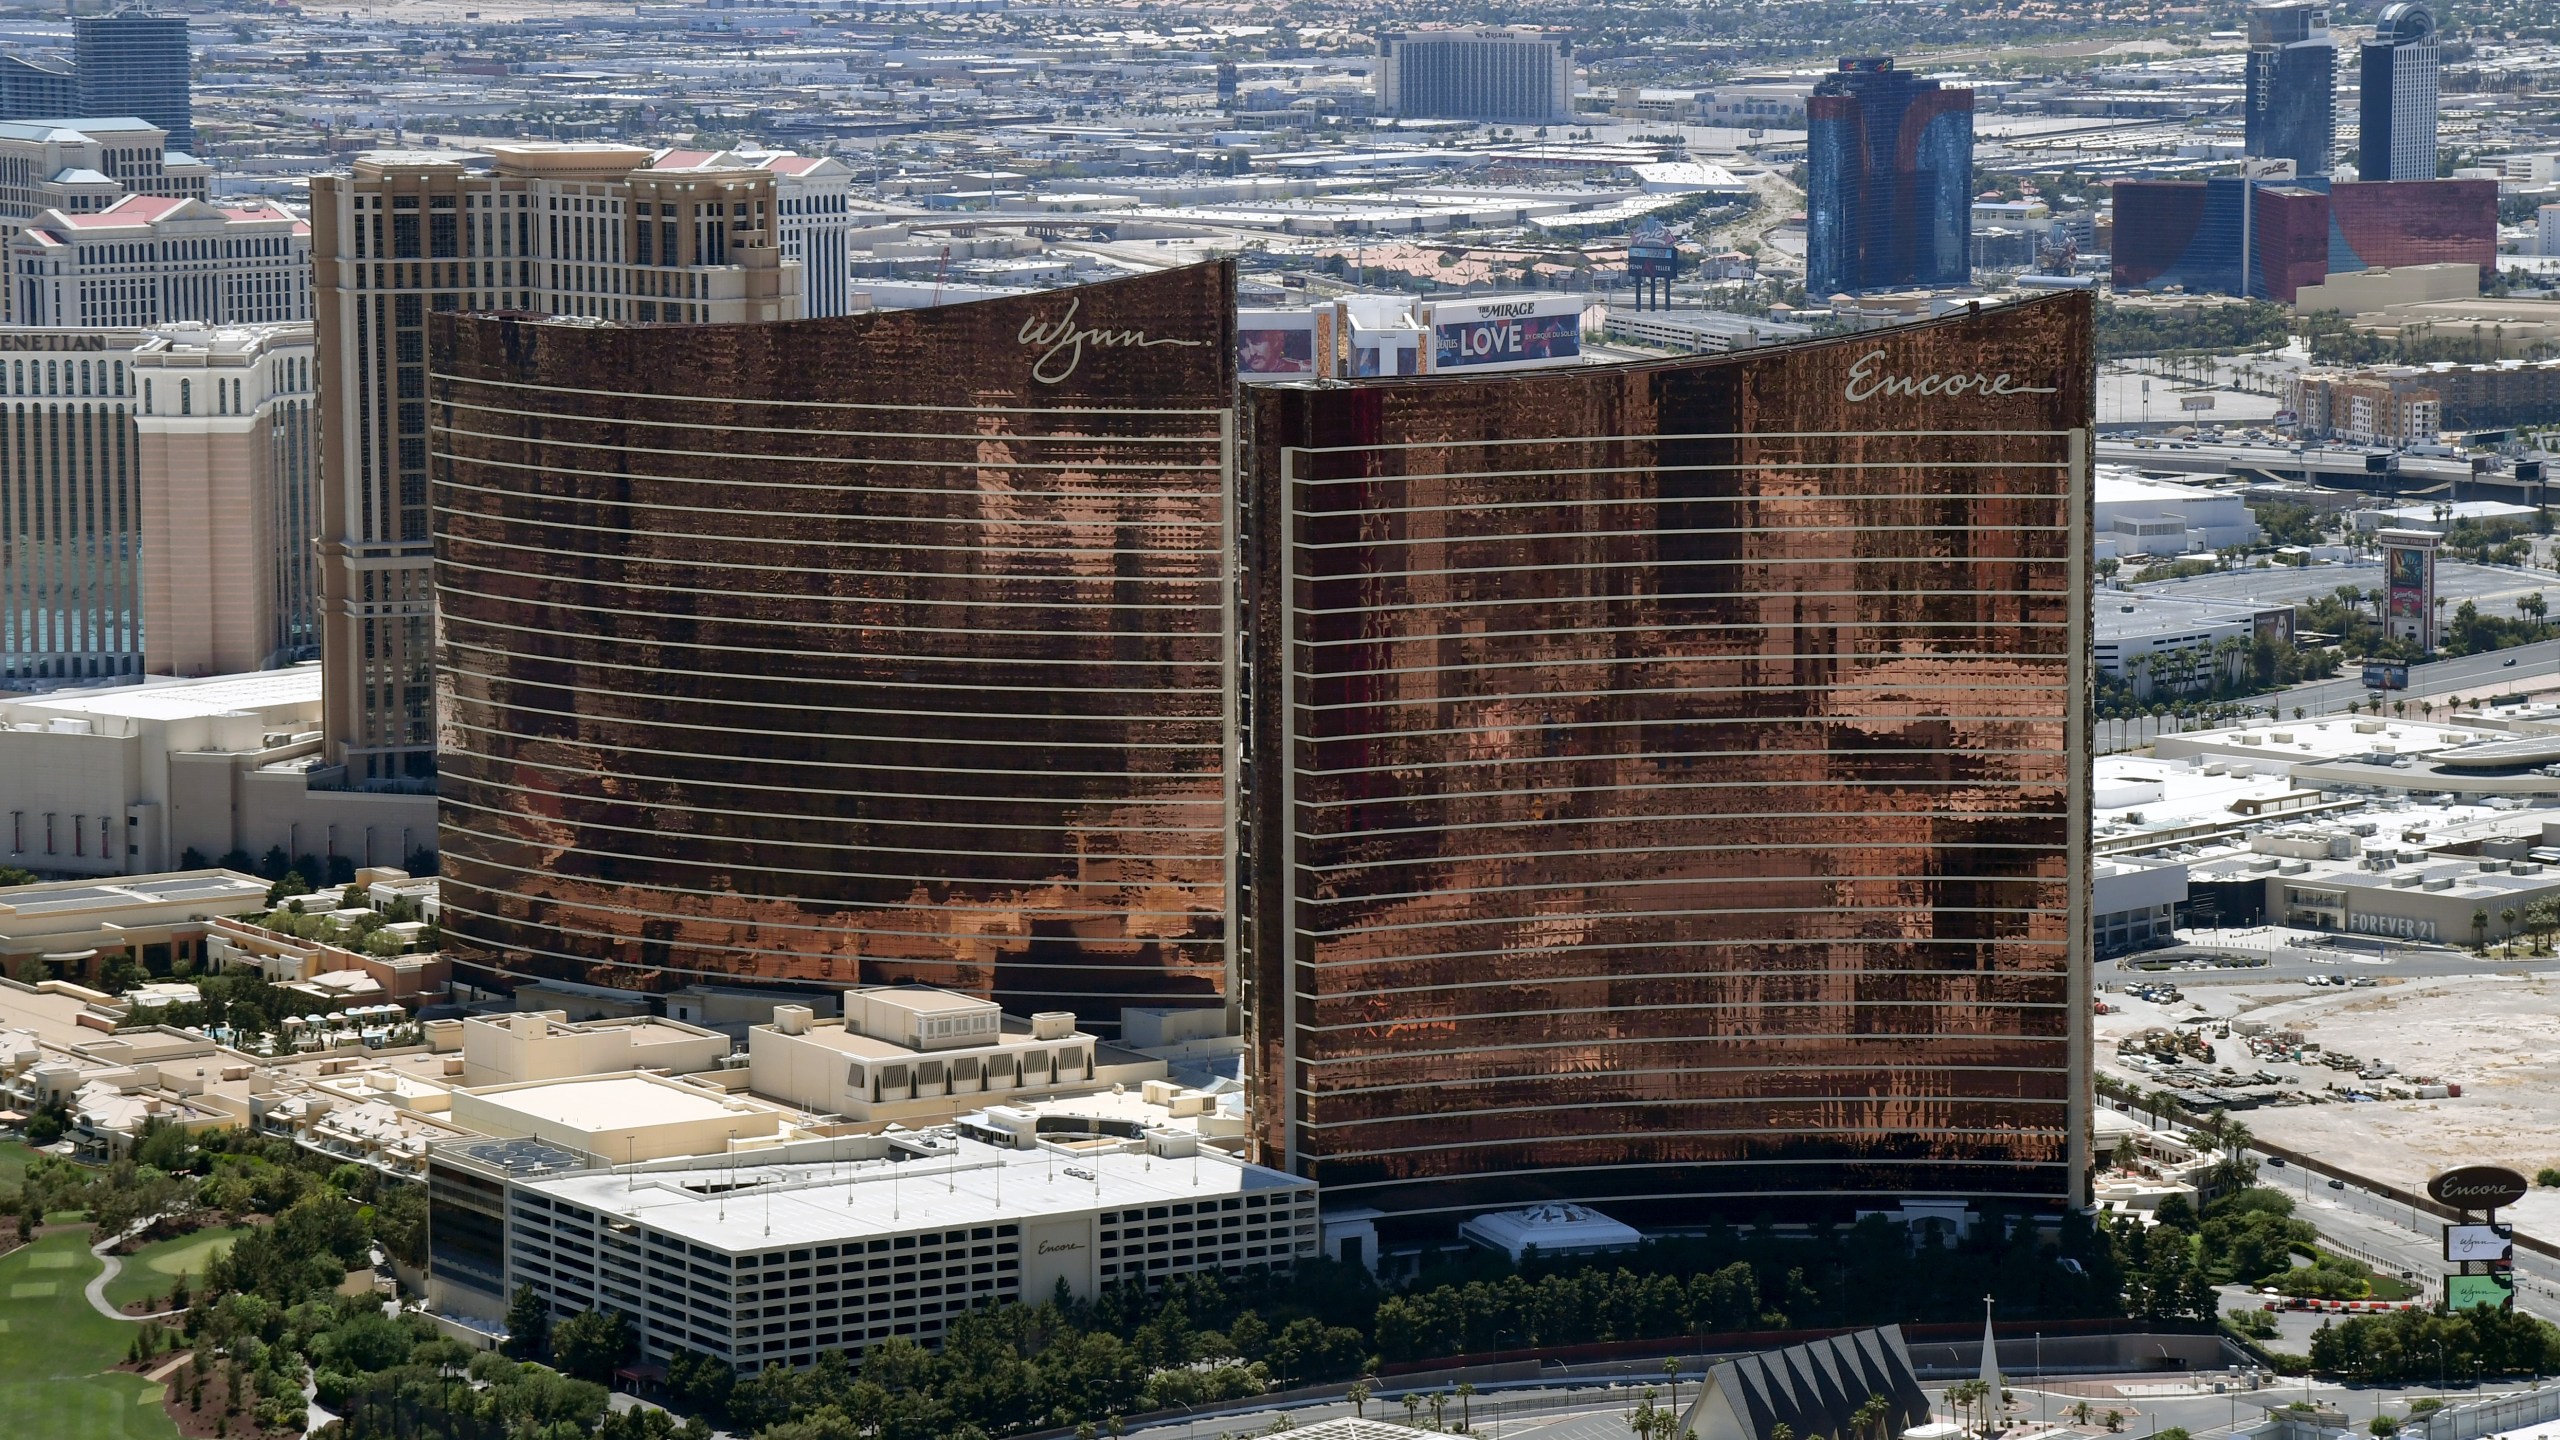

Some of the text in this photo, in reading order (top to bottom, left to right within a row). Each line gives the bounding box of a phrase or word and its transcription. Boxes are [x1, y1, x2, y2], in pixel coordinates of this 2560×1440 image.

[2417, 35, 2440, 47] PALMS
[1478, 302, 1535, 319] THE MIRAGE
[1460, 324, 1523, 357] LOVE
[1532, 332, 1551, 341] CIRQUE
[1560, 330, 1578, 338] SOLEIL
[1845, 350, 2057, 402] Encore
[2350, 912, 2436, 940] FOREVER 21
[2440, 1176, 2525, 1198] Encore
[1038, 1239, 1086, 1255] Encore
